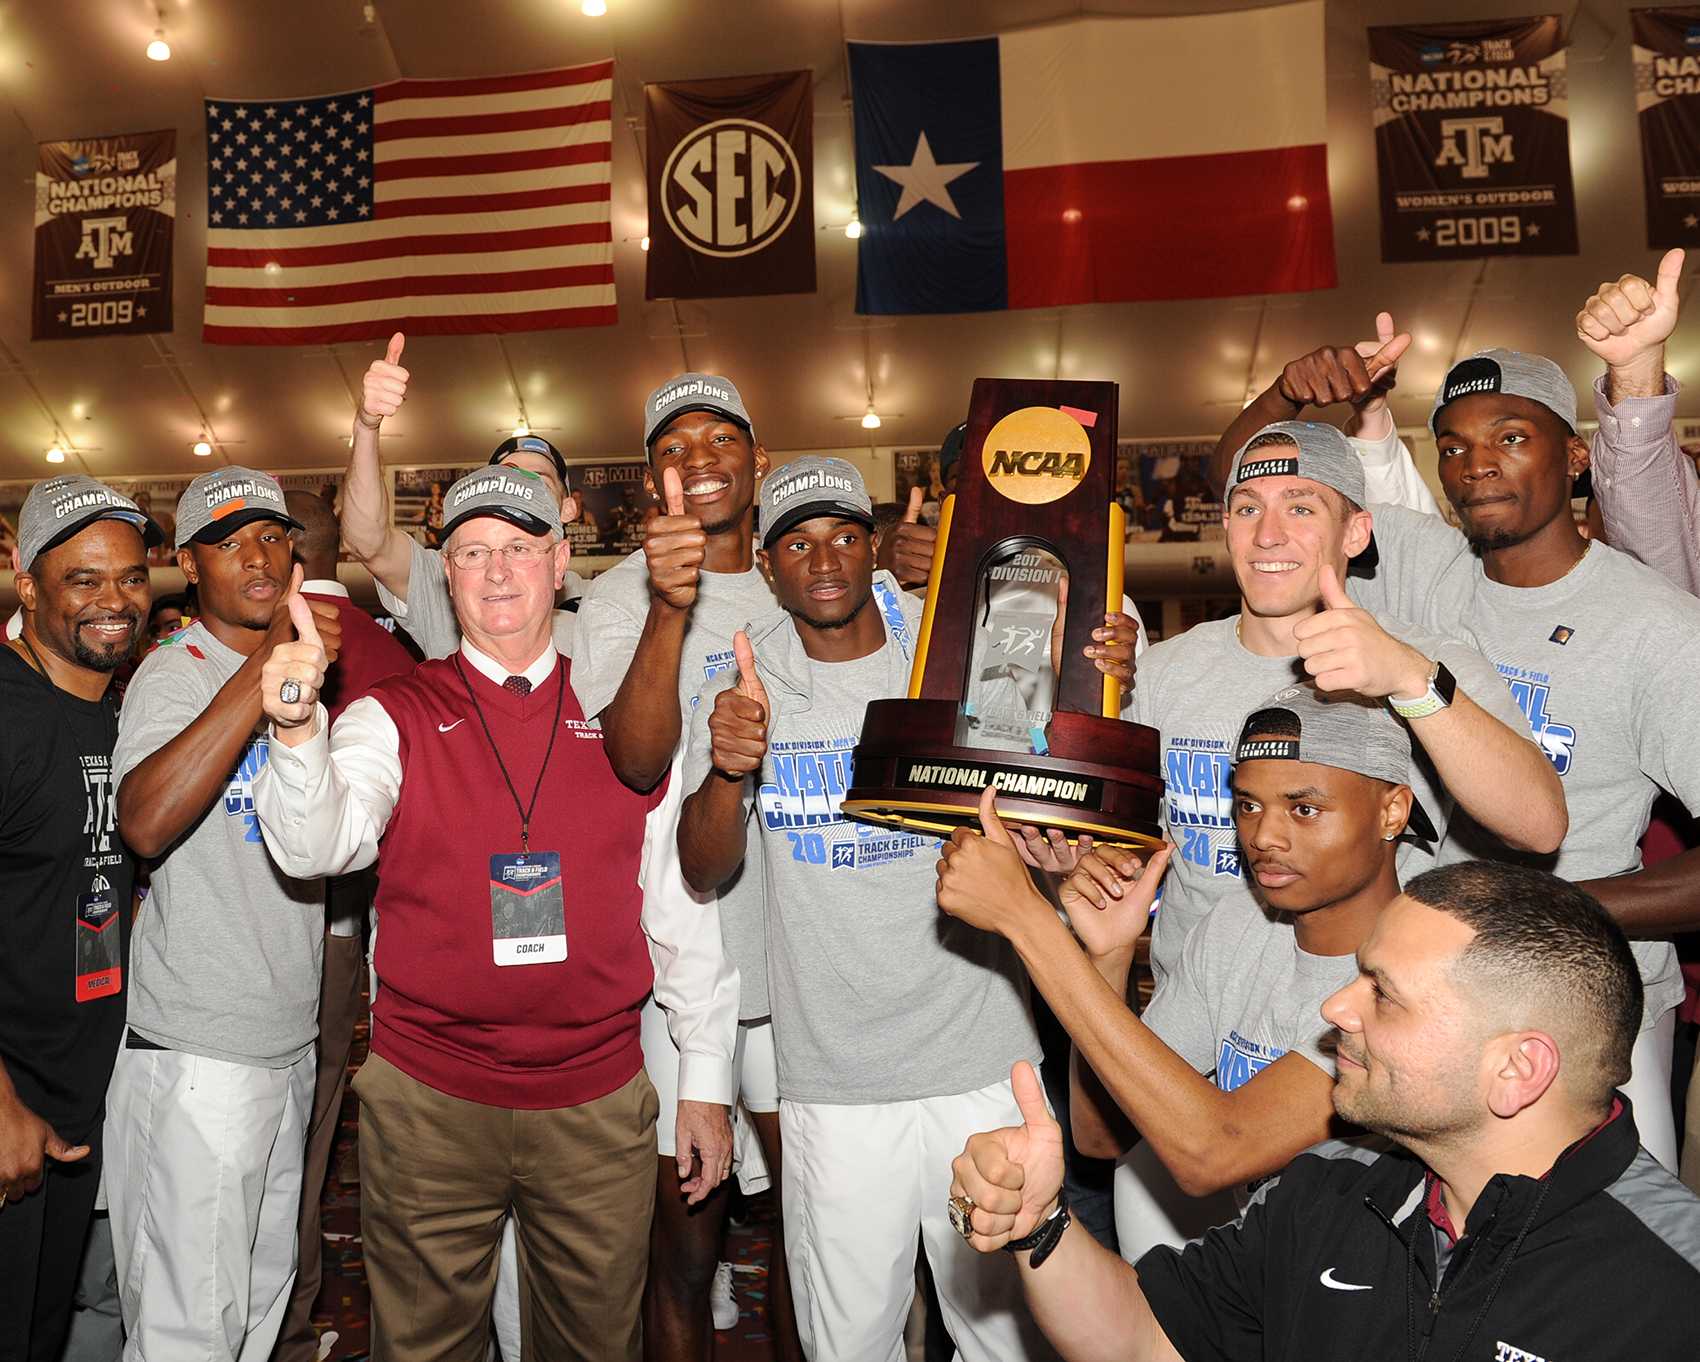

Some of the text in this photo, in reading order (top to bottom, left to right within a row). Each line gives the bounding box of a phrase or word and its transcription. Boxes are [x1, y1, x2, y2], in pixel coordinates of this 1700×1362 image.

[1391, 66, 1548, 93] NATIONAL
[1391, 86, 1549, 113] CHAMPIONS
[50, 173, 162, 199] NATIONAL
[672, 129, 787, 246] SEC
[49, 191, 162, 214] CHAMPIONS
[1397, 189, 1554, 208] WOMEN'S OUTDOOR
[1435, 216, 1522, 246] 2009
[54, 278, 150, 294] MEN'S OUTDOOR
[71, 300, 133, 326] 2009
[989, 450, 1085, 480] NCAA
[1012, 554, 1041, 567] 2017
[990, 567, 1053, 584] DIVISION
[792, 740, 825, 750] DIVISION
[1190, 738, 1224, 749] DIVISION
[908, 764, 1089, 802] NATIONAL CHAMPION
[858, 841, 890, 855] TRACK
[891, 839, 900, 851] &
[858, 849, 914, 864] CHAMPIONSHIPS
[1182, 827, 1210, 867] 20
[516, 943, 545, 954] COACH
